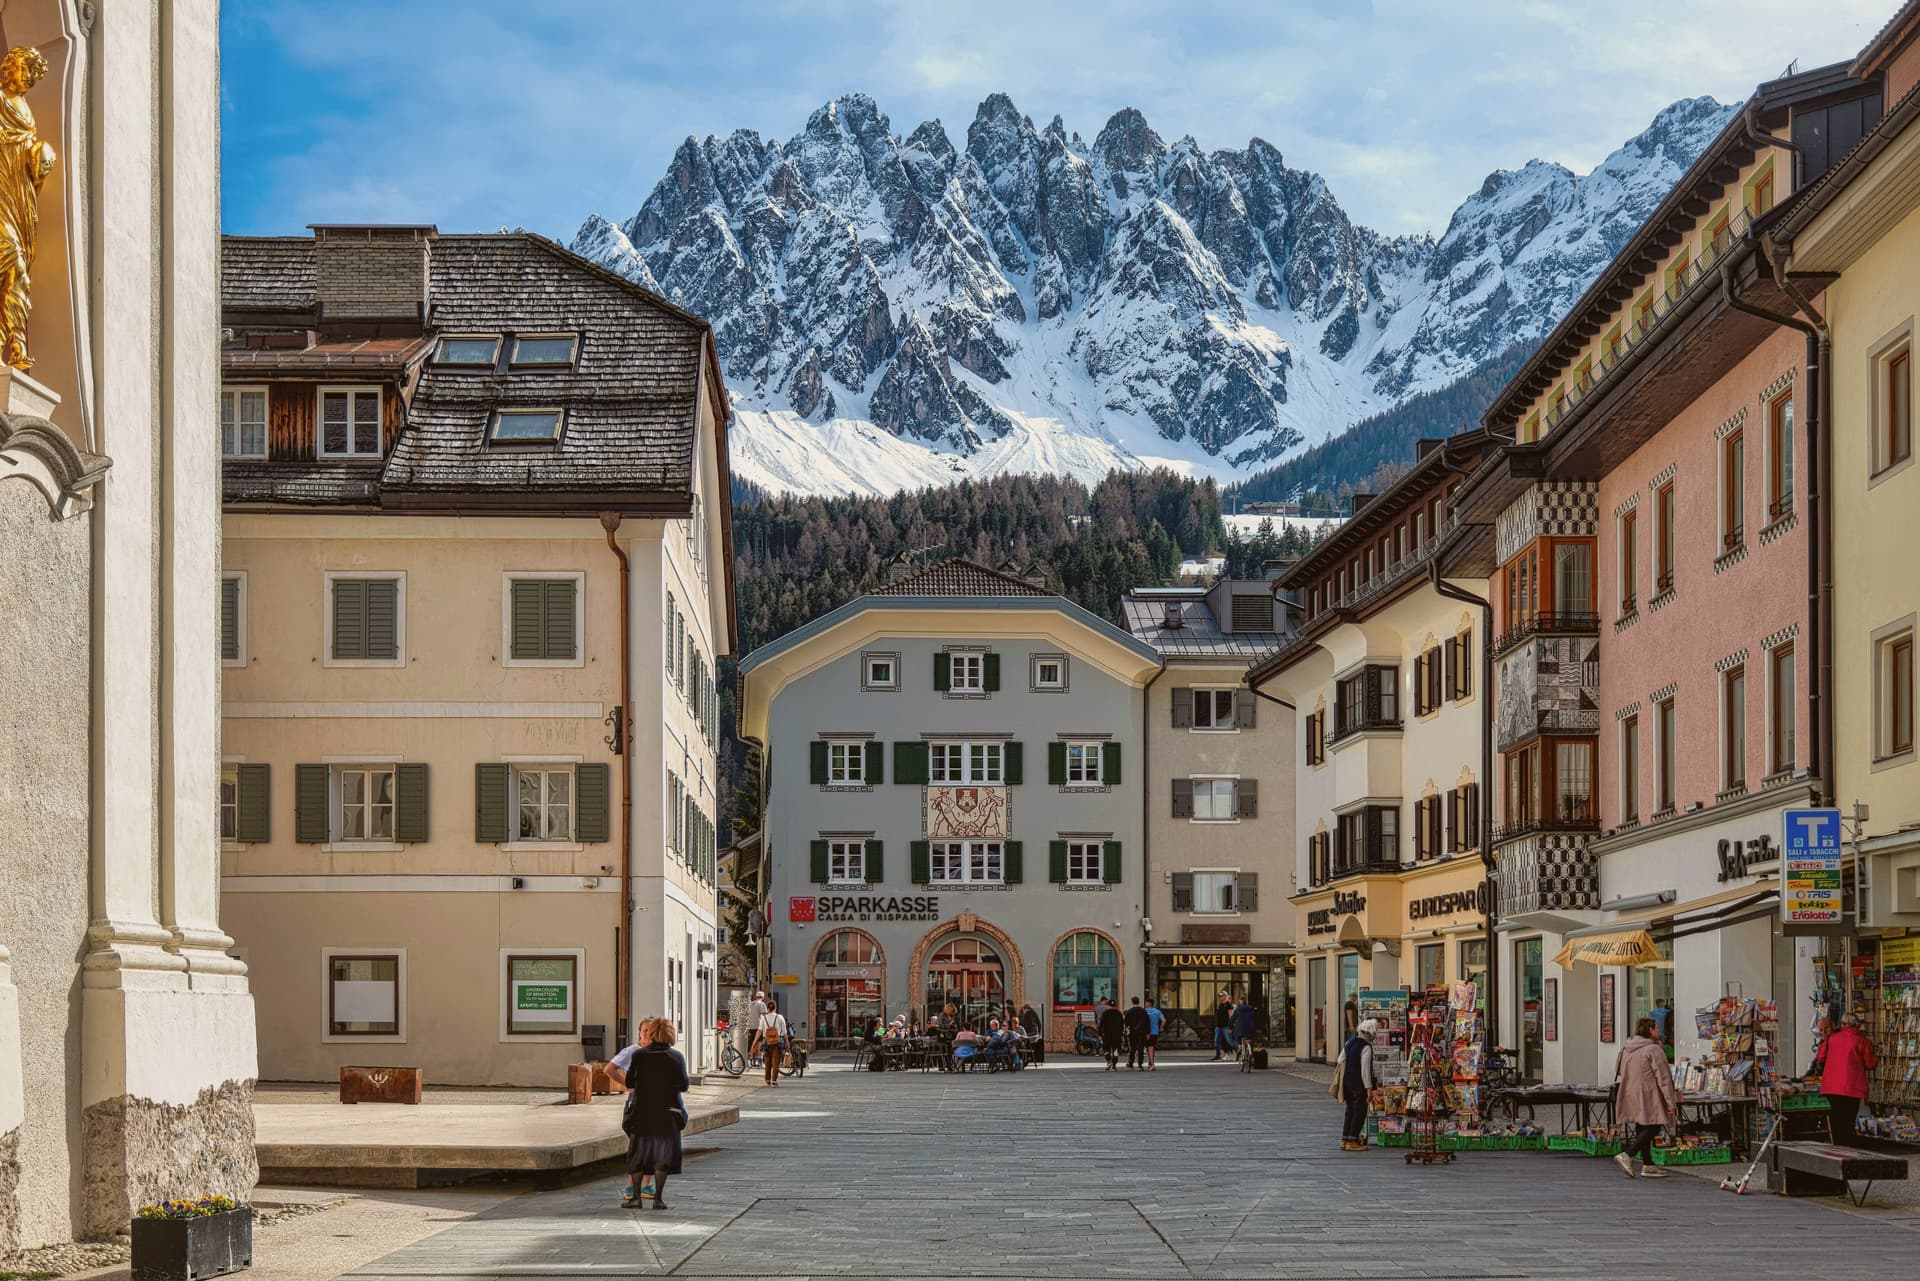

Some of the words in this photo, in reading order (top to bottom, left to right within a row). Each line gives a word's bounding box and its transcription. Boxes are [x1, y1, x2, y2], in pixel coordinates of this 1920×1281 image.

[1797, 817, 1829, 847] T
[1788, 861, 1822, 869] LOTTO
[1806, 890, 1831, 899] TRIS
[818, 896, 939, 913] SPARKASSE
[1409, 889, 1476, 920] EUROSPAR
[818, 913, 854, 921] CASSA
[860, 913, 871, 921] DI
[876, 913, 939, 921] RISPARMIO
[1792, 911, 1831, 920] Enalotto
[1616, 941, 1642, 956] LOTTO
[1172, 955, 1257, 967] JUWELIER
